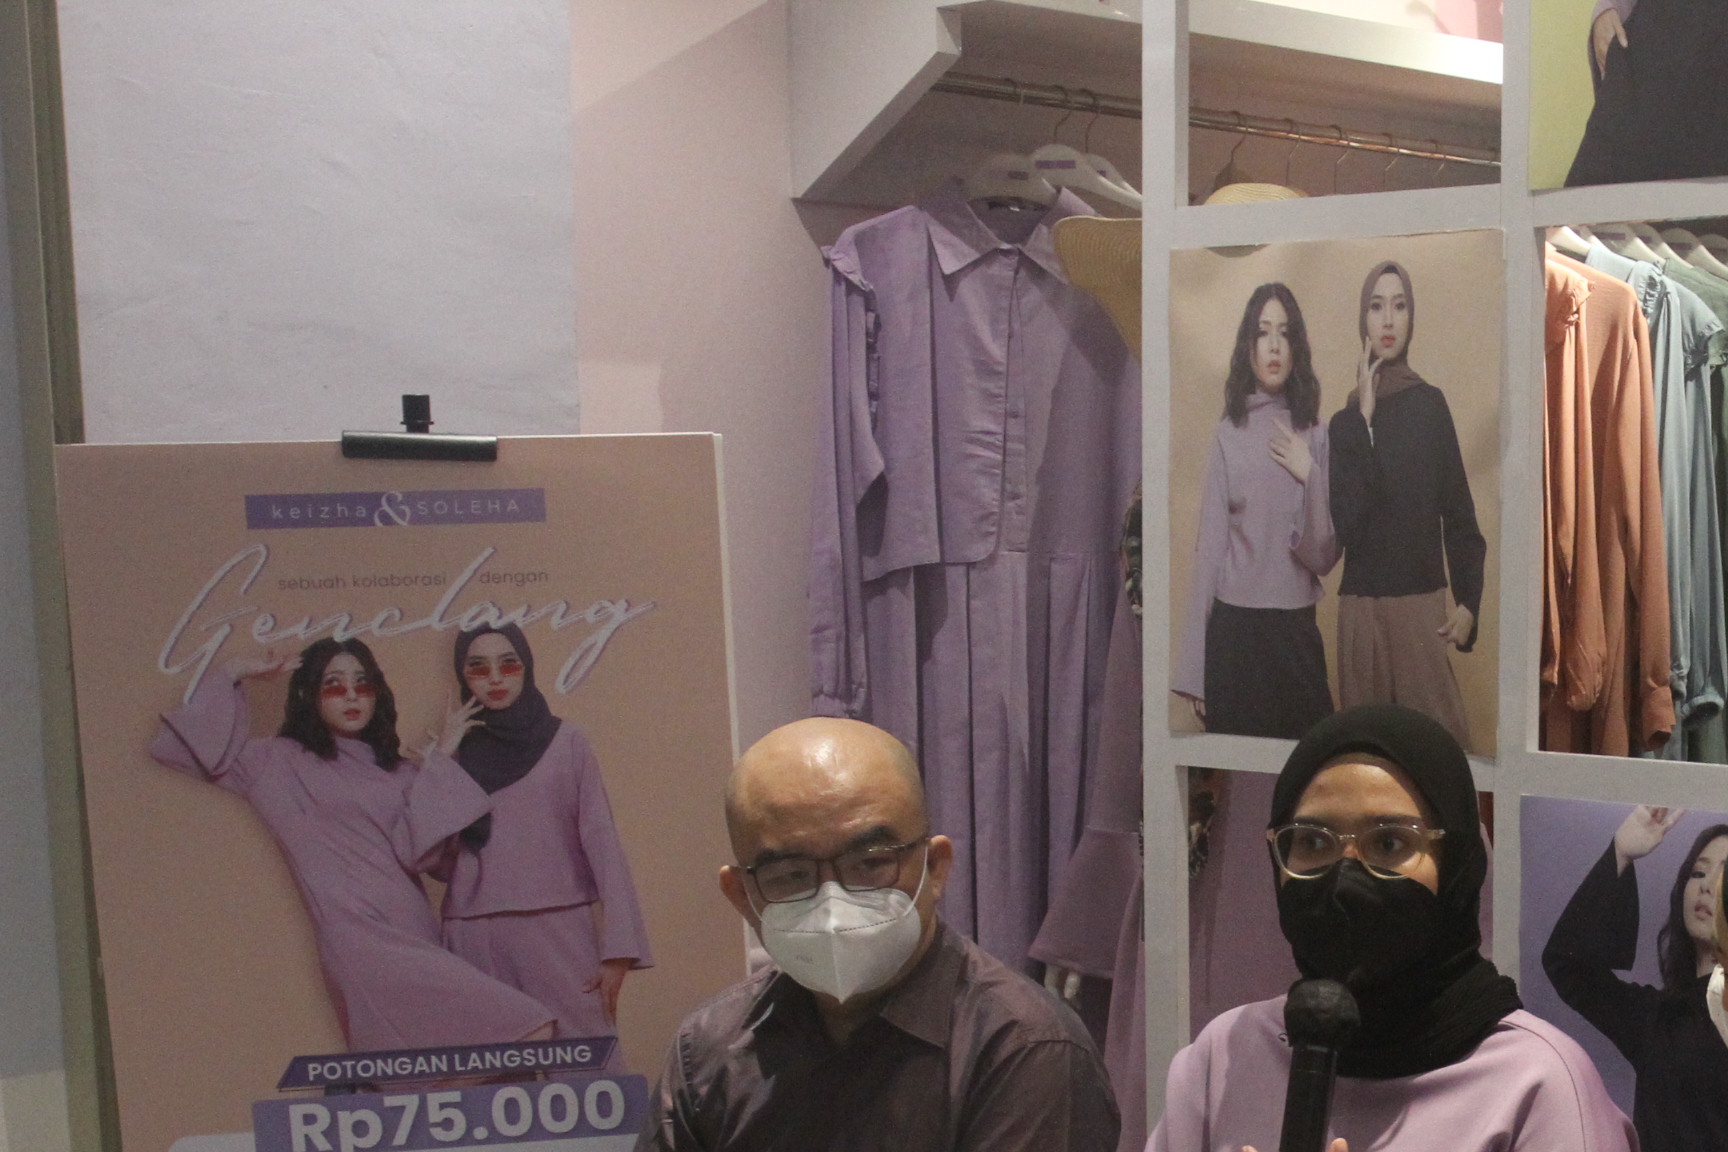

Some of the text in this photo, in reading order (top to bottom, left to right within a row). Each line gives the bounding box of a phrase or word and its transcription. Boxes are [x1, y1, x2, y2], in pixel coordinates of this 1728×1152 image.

[272, 503, 367, 520] keizha
[417, 498, 520, 516] SOLEHA
[278, 569, 549, 591] sebuah kolaborasi dengan
[307, 1044, 592, 1082] POTONGAN LANGSUNG
